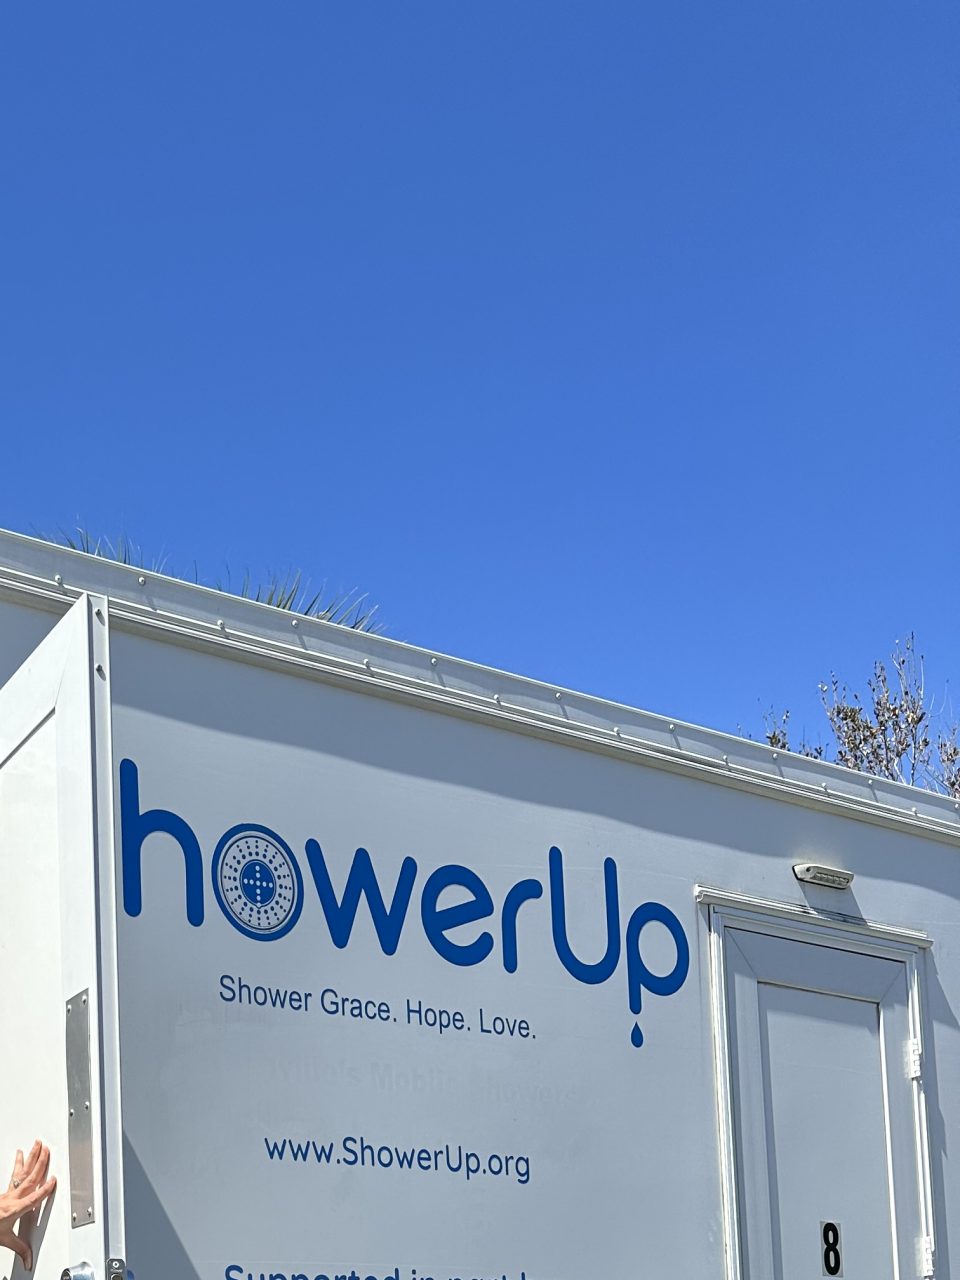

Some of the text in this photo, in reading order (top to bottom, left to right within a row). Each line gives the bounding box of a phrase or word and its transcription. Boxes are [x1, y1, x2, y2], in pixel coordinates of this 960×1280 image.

[219, 974, 536, 1039] Shower Grace. Hope. Love.
[265, 1136, 530, 1185] www.ShowerUp.org
[823, 1223, 841, 1276] 8
